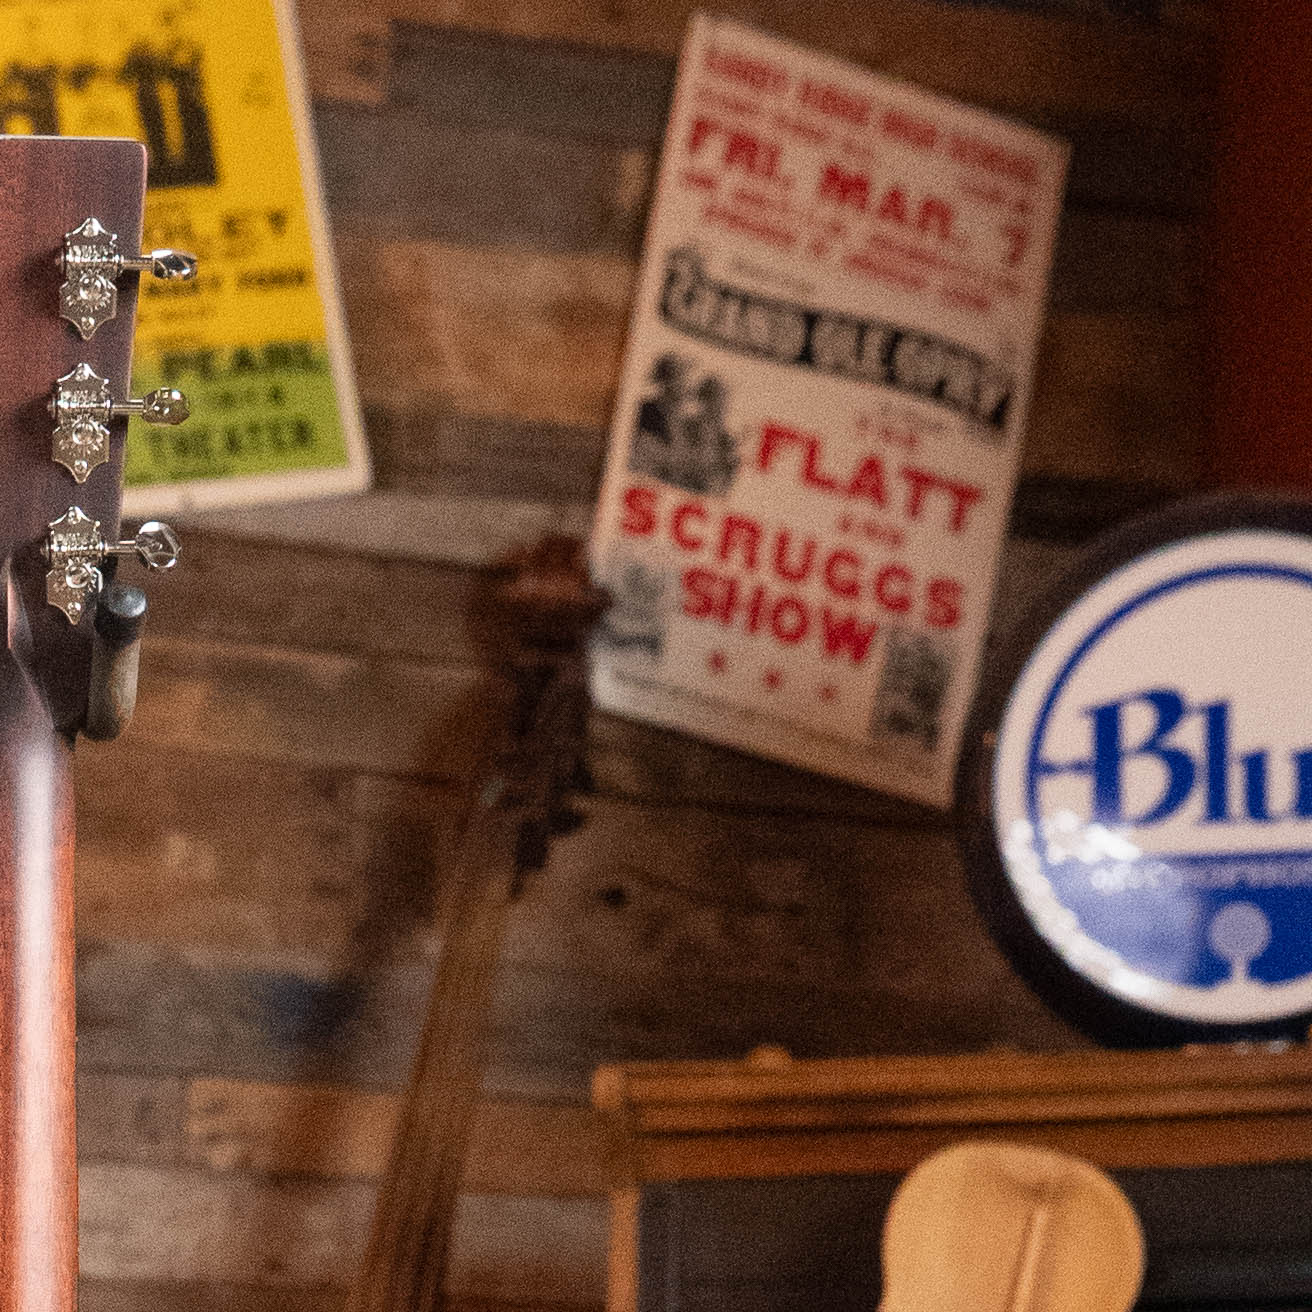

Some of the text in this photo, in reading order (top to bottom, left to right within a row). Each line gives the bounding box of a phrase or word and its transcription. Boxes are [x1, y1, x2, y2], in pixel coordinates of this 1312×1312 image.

[756, 418, 986, 536] FLATT
[620, 485, 966, 630] SCRUGGS
[680, 565, 878, 665] SHOW
